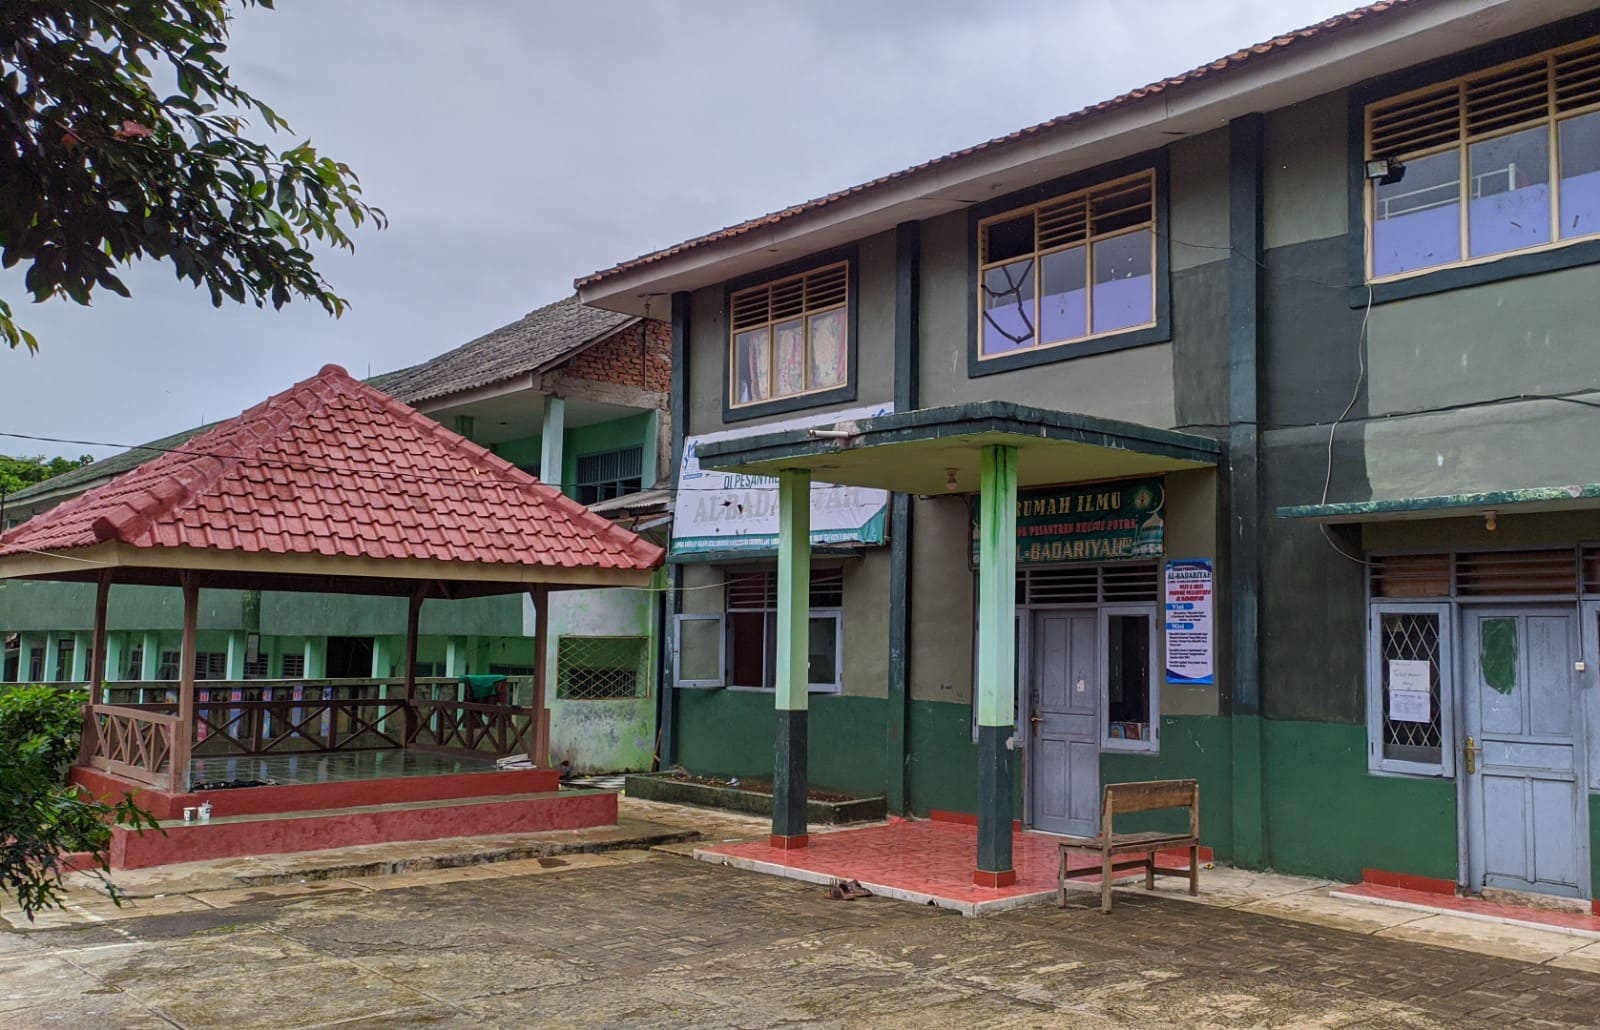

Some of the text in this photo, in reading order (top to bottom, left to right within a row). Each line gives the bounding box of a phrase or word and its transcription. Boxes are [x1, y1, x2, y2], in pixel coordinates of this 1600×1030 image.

[724, 475, 733, 488] DI
[1078, 491, 1121, 513] ILMU
[1017, 537, 1123, 562] L-BADARIYAH
